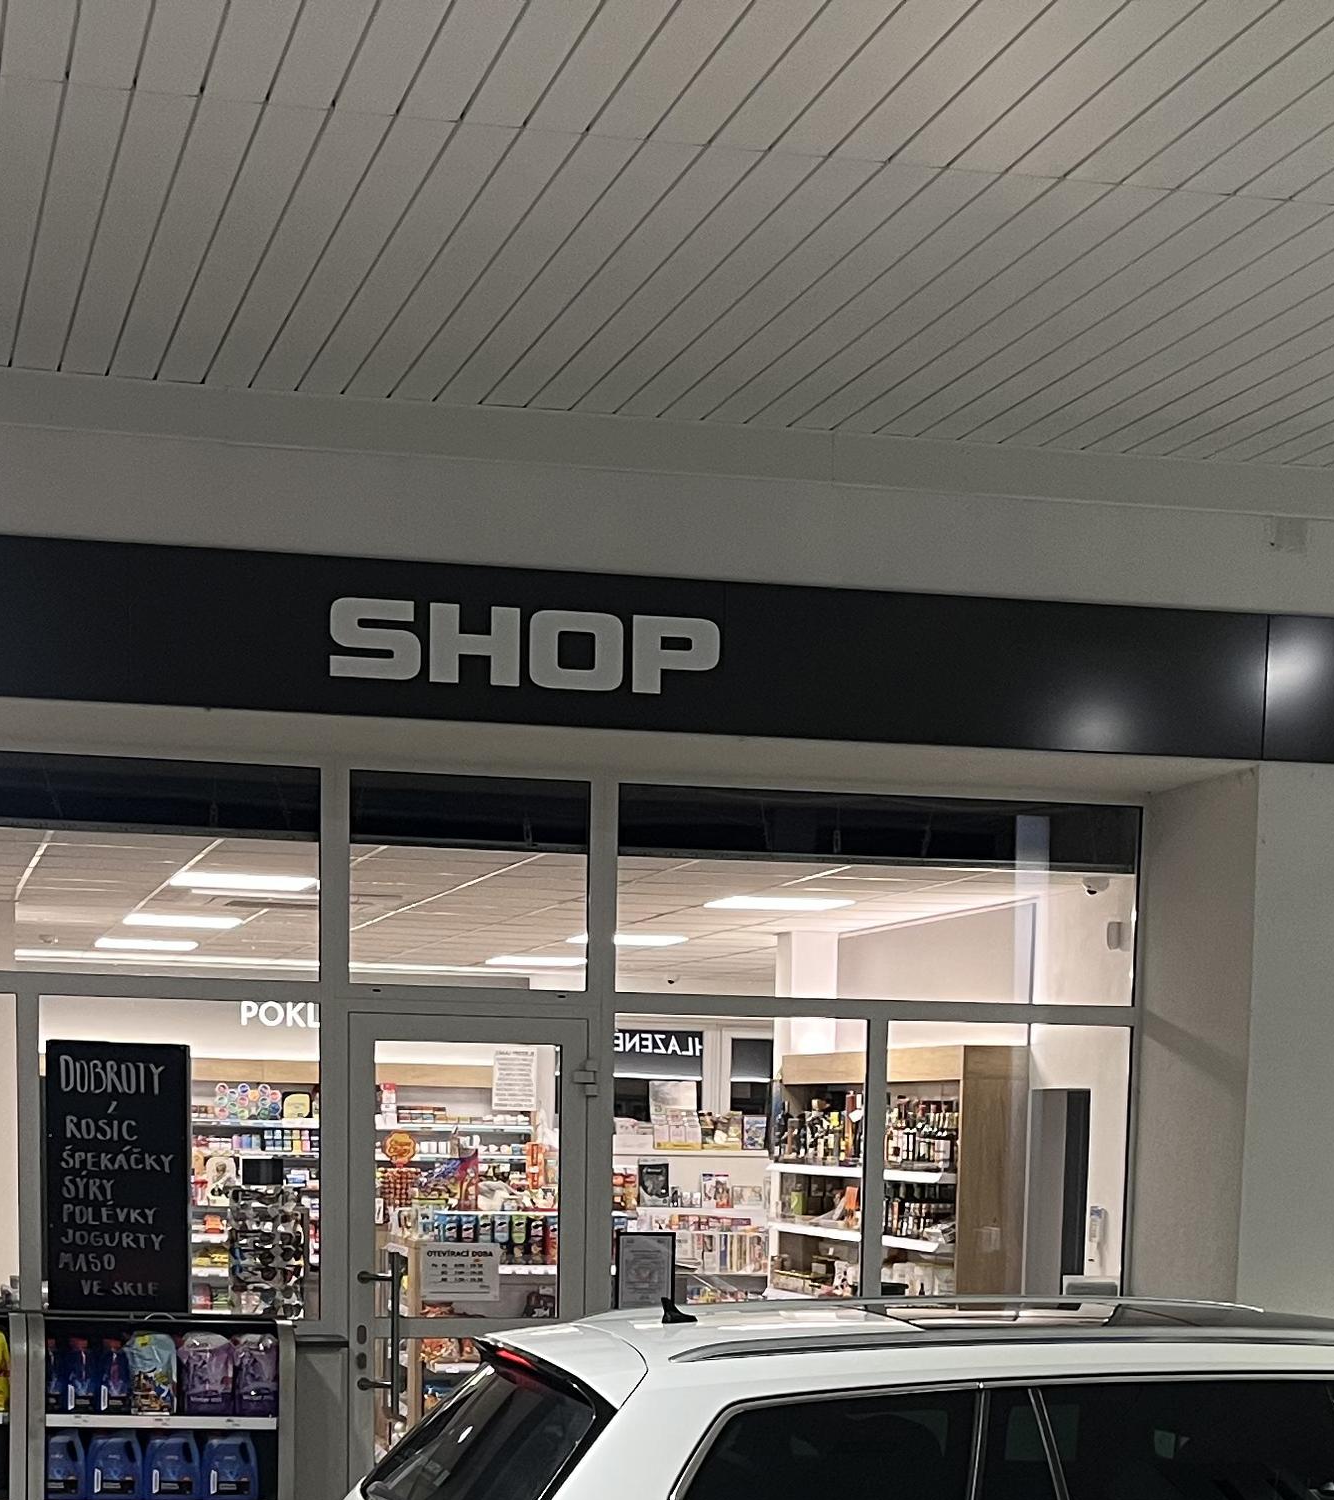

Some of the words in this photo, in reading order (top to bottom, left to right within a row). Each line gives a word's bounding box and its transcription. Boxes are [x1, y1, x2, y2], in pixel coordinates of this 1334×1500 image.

[329, 596, 721, 695] SHOP
[59, 1054, 166, 1096] DOBROTY
[61, 1169, 116, 1202] SÝRY
[62, 1200, 158, 1226] POLÉVKY
[59, 1228, 167, 1251] JOGURTY
[58, 1251, 116, 1272] MASO
[427, 1248, 470, 1257] OTEVÍRACÍ
[471, 1249, 494, 1258] DOBA
[80, 1279, 106, 1296] VE
